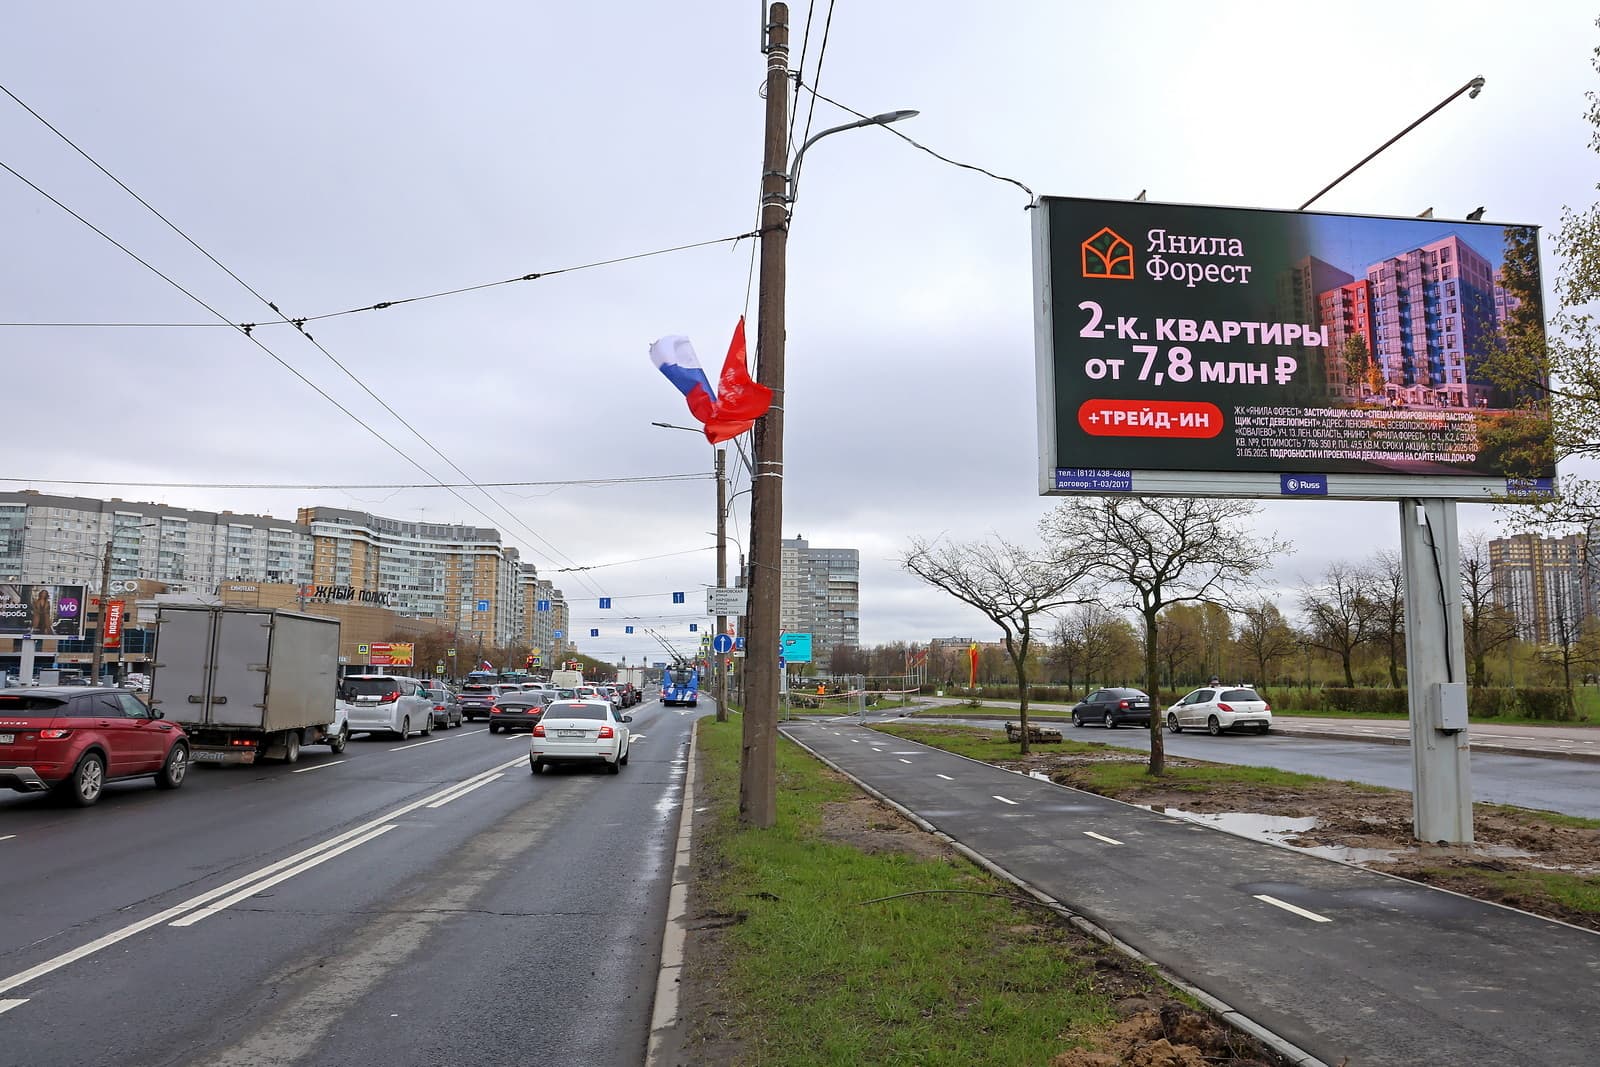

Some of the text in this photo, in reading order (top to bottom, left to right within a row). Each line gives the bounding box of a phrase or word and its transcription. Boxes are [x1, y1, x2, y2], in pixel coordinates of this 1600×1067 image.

[1146, 228, 1245, 257] Янила
[1146, 254, 1252, 288] Форест
[1155, 318, 1329, 347] КВАРТИРЫ
[1132, 345, 1194, 386] 7,8
[1275, 356, 1298, 385] ₽
[1088, 407, 1209, 429] +ТРЕЙД-ИН
[1234, 406, 1246, 414] ЖК
[1246, 406, 1273, 416] «ЯНИЛА
[1350, 409, 1364, 418] ООО
[1235, 416, 1251, 426] ЩИК
[1322, 418, 1346, 428] АДРЕС:
[1236, 438, 1248, 446] КВ.
[1262, 438, 1302, 448] СТОИМОСТЬ
[1382, 441, 1404, 450] СРОКИ
[1270, 449, 1317, 459] ПОДРОБНОСТИ
[1323, 450, 1361, 459] ПРОЕКТНАЯ
[1361, 451, 1404, 462] ДЕКЛАРАЦИЯ
[1405, 452, 1414, 460] НА
[1414, 450, 1435, 461] САЙТЕ
[1077, 470, 1095, 478] (812)
[1058, 480, 1092, 488] договор:
[1300, 480, 1320, 489] Russ
[59, 602, 77, 612] wb
[108, 605, 120, 634] ПОБЕДА!
